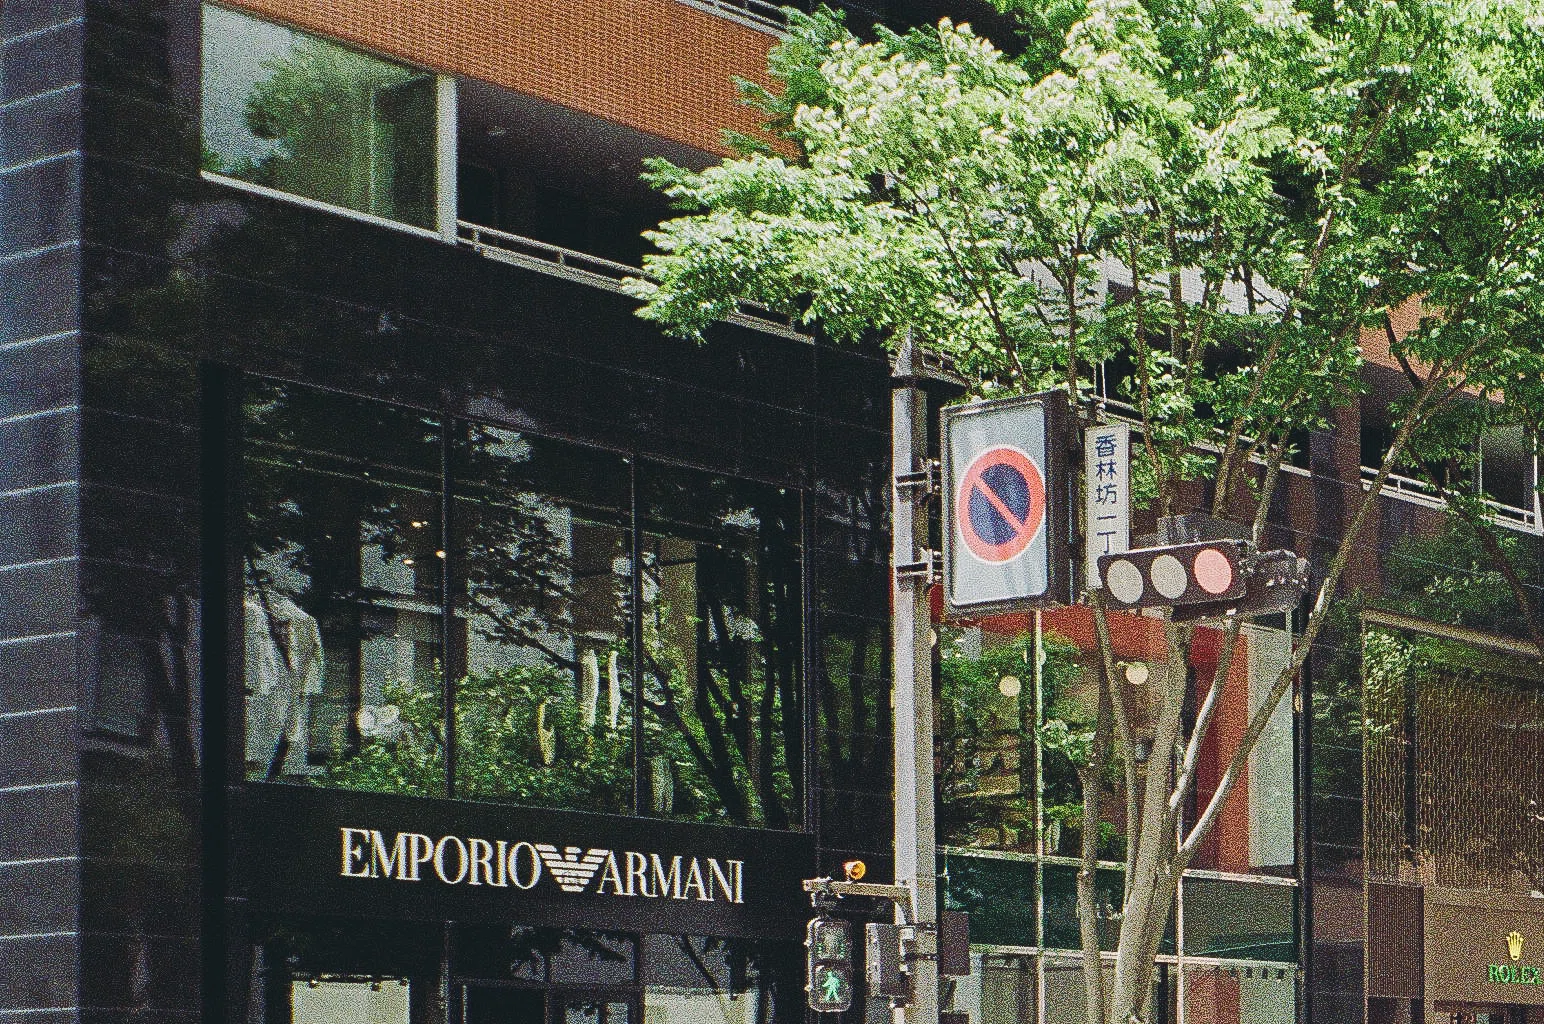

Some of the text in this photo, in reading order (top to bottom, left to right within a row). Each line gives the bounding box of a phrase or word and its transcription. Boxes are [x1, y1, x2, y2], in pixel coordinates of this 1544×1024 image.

[1094, 433, 1118, 556] 香林坊一丁
[339, 827, 745, 904] EMPORIO ARMANI
[1488, 963, 1544, 985] ROLEX
